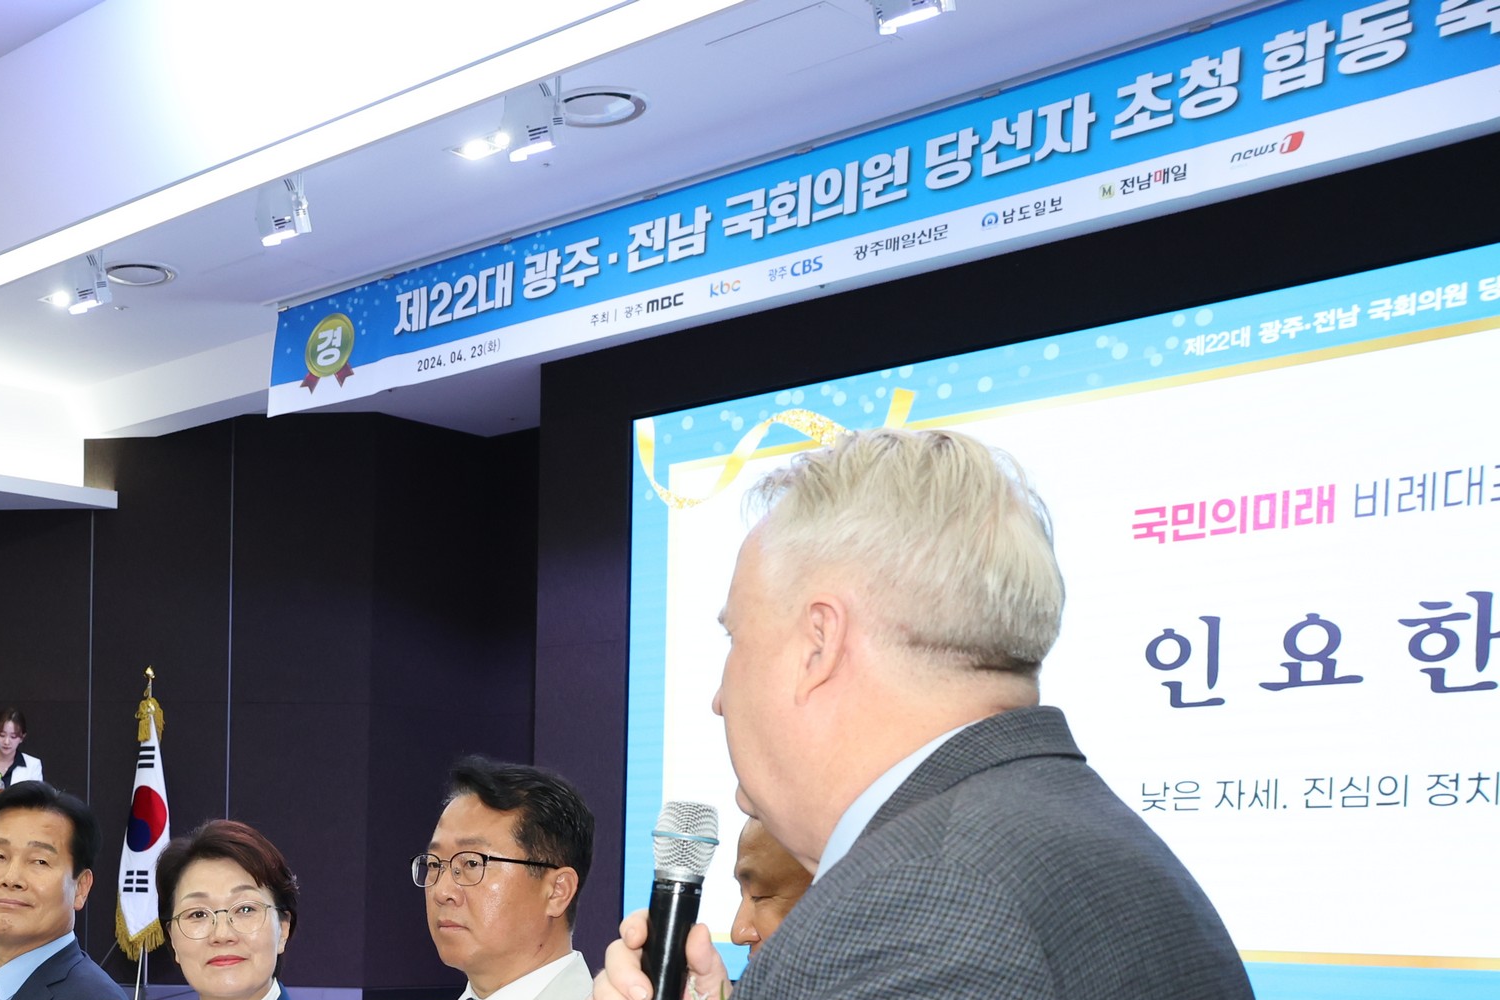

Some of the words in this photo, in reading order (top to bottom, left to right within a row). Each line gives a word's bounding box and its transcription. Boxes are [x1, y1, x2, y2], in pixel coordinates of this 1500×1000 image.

[394, 261, 514, 336] 제22대
[722, 147, 910, 241] 국회의원
[925, 92, 1097, 190] 당선자
[1110, 46, 1241, 140] 초청
[1261, 0, 1413, 100] 합동
[590, 312, 609, 327] 주최
[624, 303, 643, 319] 광주
[709, 279, 741, 298] kbc
[768, 265, 787, 282] 광주
[790, 255, 824, 277] CBS
[853, 224, 949, 261] 광주매일신문
[1002, 196, 1063, 225] 남도일보
[1120, 163, 1188, 195] 전남매일
[316, 326, 344, 369] 경
[417, 354, 447, 372] 2024.
[449, 350, 467, 365] 04.
[471, 337, 501, 359] 23(화)
[1183, 325, 1251, 356] 제22대
[1367, 281, 1469, 321] 국회의원
[1131, 483, 1337, 545] 국민의미래
[1354, 464, 1500, 519] 비례대
[1140, 779, 1202, 812] 낮은
[1214, 777, 1288, 810] 자세.
[1303, 774, 1409, 809] 진심의
[1426, 771, 1500, 807] 정치
